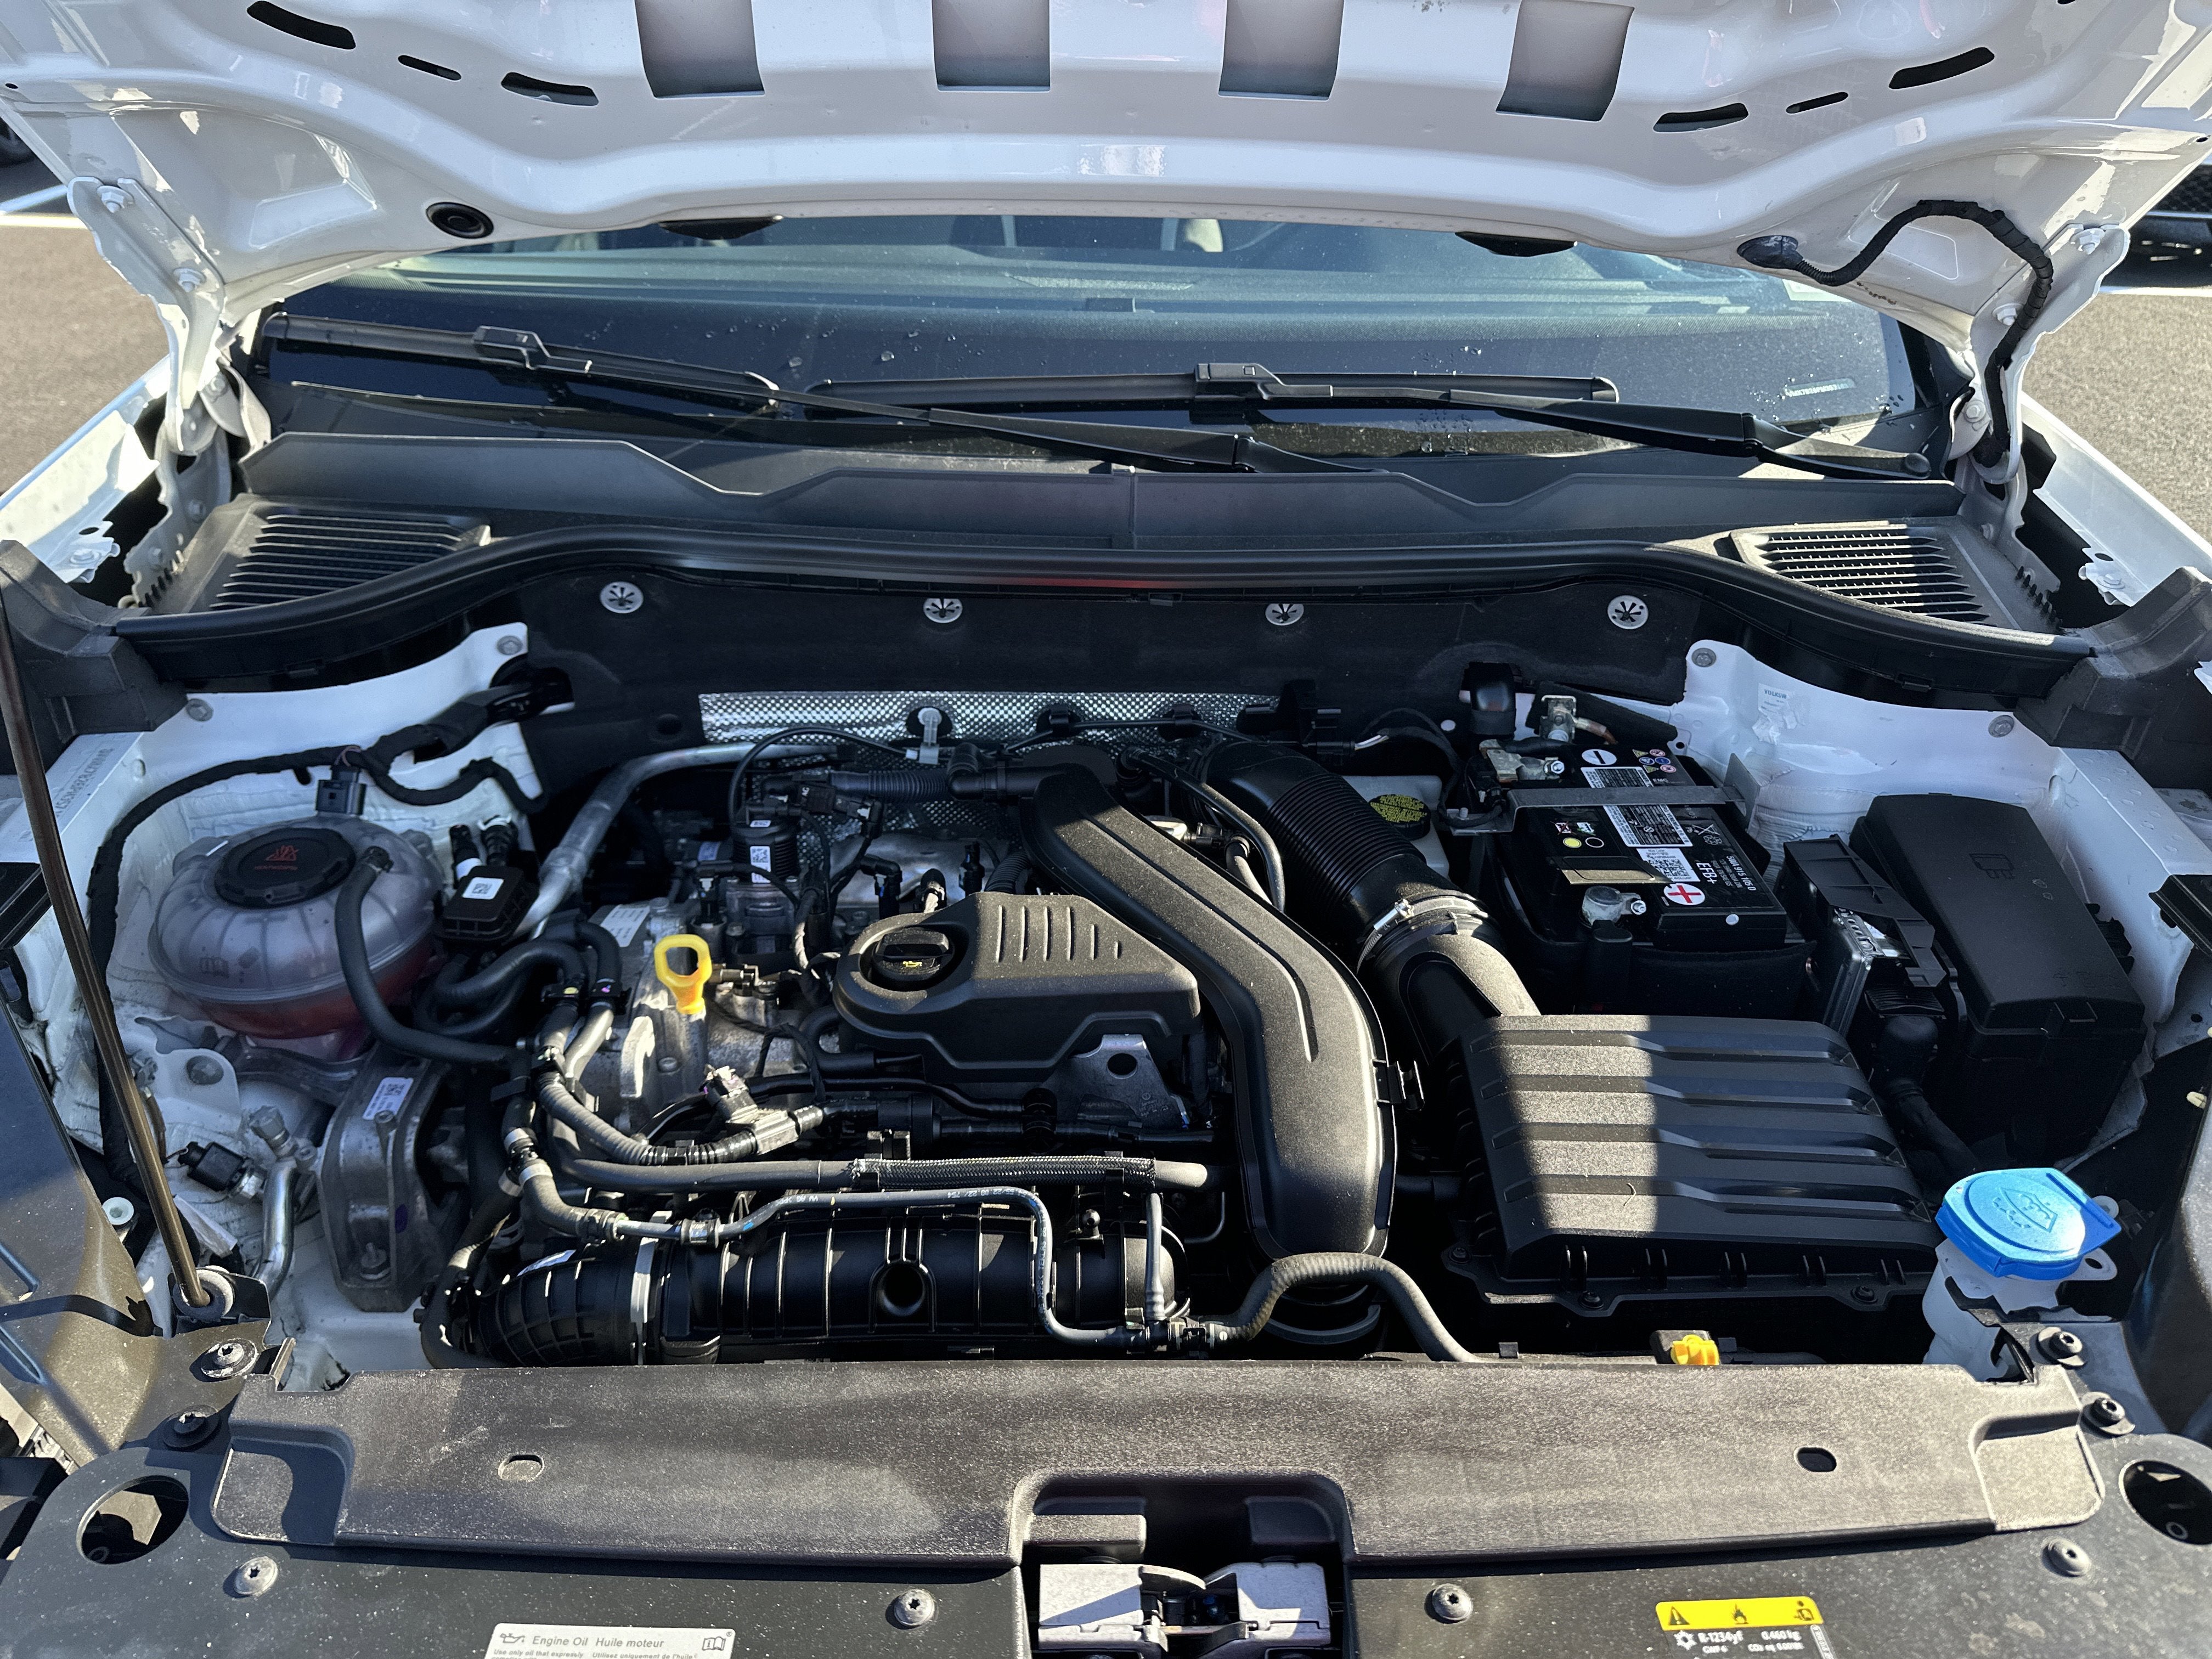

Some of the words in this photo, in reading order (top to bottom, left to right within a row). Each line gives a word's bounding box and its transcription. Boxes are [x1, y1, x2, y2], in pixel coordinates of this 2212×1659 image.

[1764, 689, 1787, 699] VOLKSW
[1696, 862, 1718, 884] EFB+
[1734, 867, 1747, 876] 915
[1741, 877, 1753, 886] 105
[796, 1194, 806, 1203] AG
[532, 1636, 569, 1646] Engine
[573, 1637, 589, 1646] Oil
[596, 1638, 623, 1646] Huile
[626, 1639, 664, 1647] moteur
[1697, 1630, 1743, 1645] R-1234yf
[1786, 1629, 1802, 1641] kg
